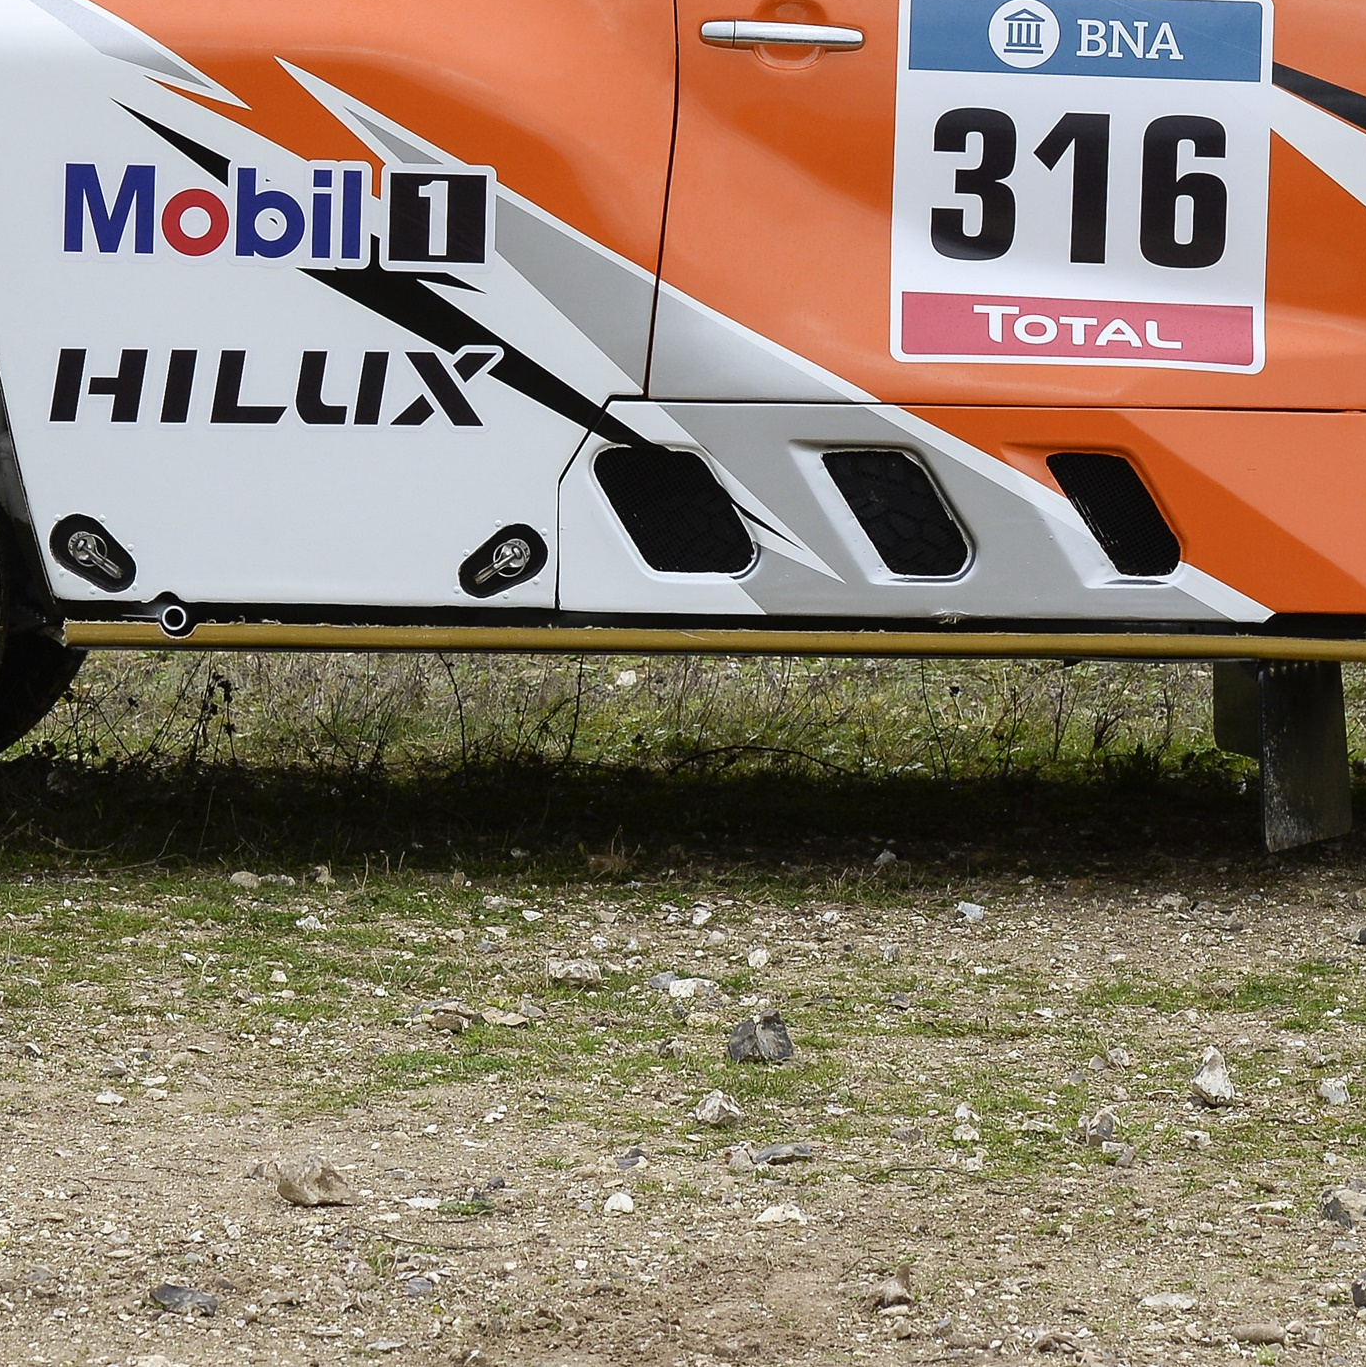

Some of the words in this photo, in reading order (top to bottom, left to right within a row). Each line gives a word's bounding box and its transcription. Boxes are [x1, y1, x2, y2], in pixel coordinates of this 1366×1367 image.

[1075, 19, 1184, 61] BNA
[63, 163, 363, 260] Mobil
[930, 107, 1228, 269] 316
[973, 304, 1183, 350] TOTAL
[49, 348, 498, 427] HILUX
